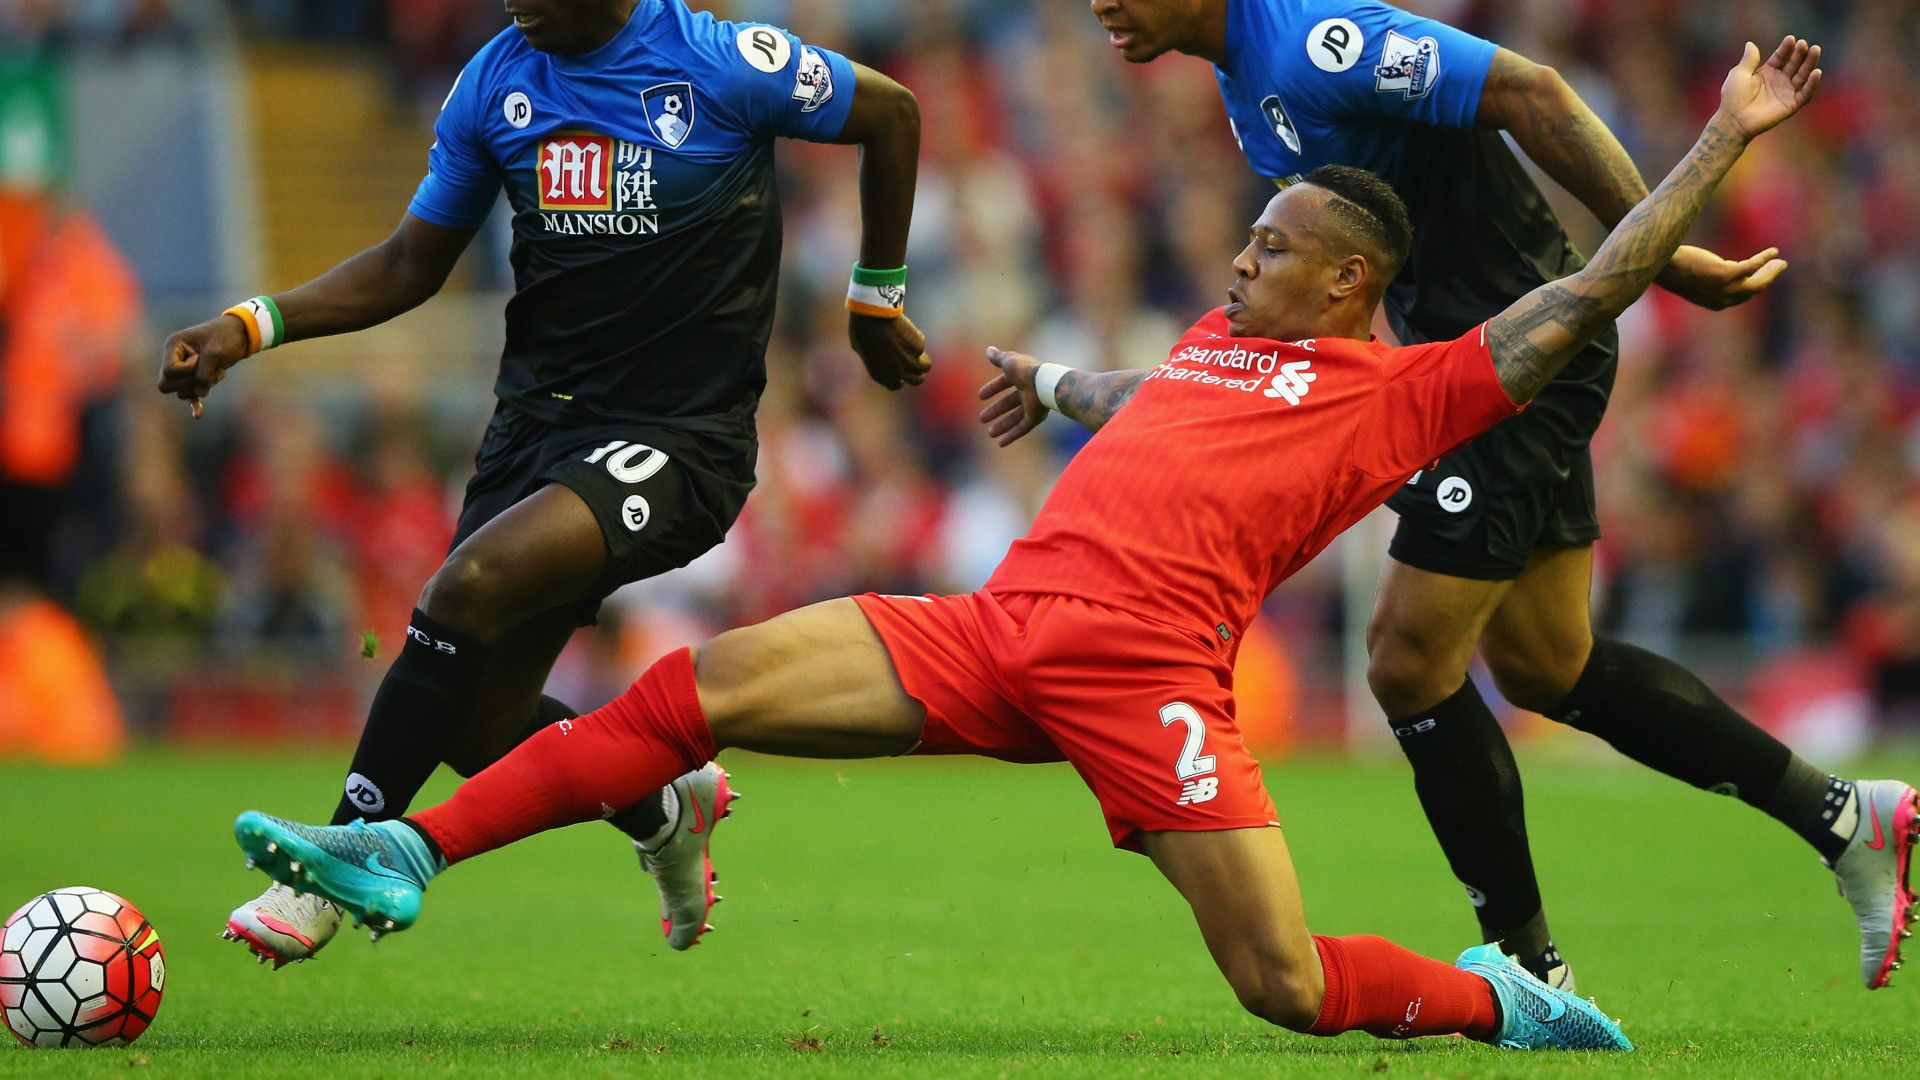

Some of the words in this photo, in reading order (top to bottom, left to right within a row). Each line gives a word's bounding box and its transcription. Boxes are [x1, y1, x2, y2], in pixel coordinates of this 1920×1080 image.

[752, 30, 777, 66] JD
[1320, 24, 1350, 65] JD
[1411, 53, 1425, 91] BARCLAYS
[512, 102, 528, 122] JD
[539, 213, 660, 236] MANSION
[1171, 343, 1279, 374] Standard
[583, 440, 670, 484] 10
[1442, 486, 1467, 504] JD
[626, 505, 645, 526] JD
[1158, 701, 1217, 781] 2
[348, 783, 378, 806] JD
